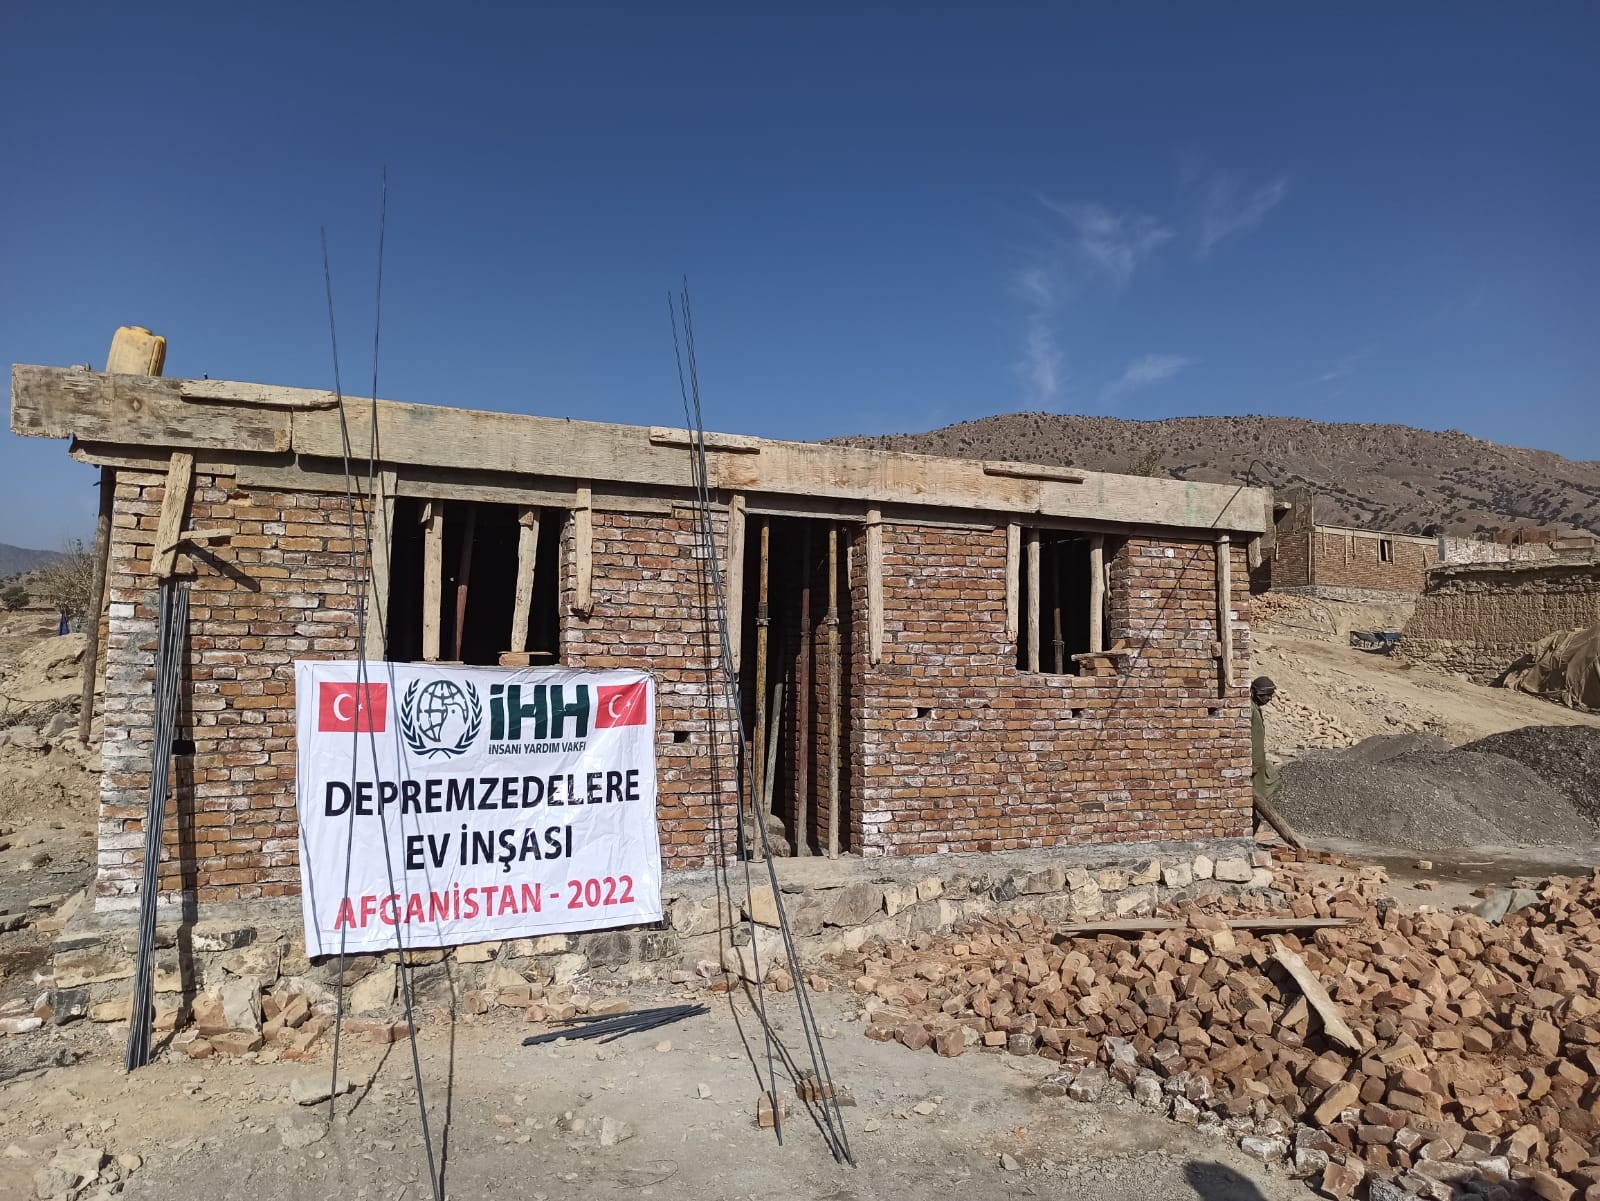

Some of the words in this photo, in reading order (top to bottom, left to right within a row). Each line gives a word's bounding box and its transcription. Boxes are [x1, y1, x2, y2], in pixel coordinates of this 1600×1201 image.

[523, 742, 560, 754] YARDIM
[561, 741, 587, 753] VAKFI
[324, 769, 640, 817] DEPREMZEDELERE
[406, 833, 451, 871] EV
[459, 823, 573, 873] İNŞASI
[333, 882, 542, 930] AFGANİSTAN
[567, 875, 635, 910] 2022
